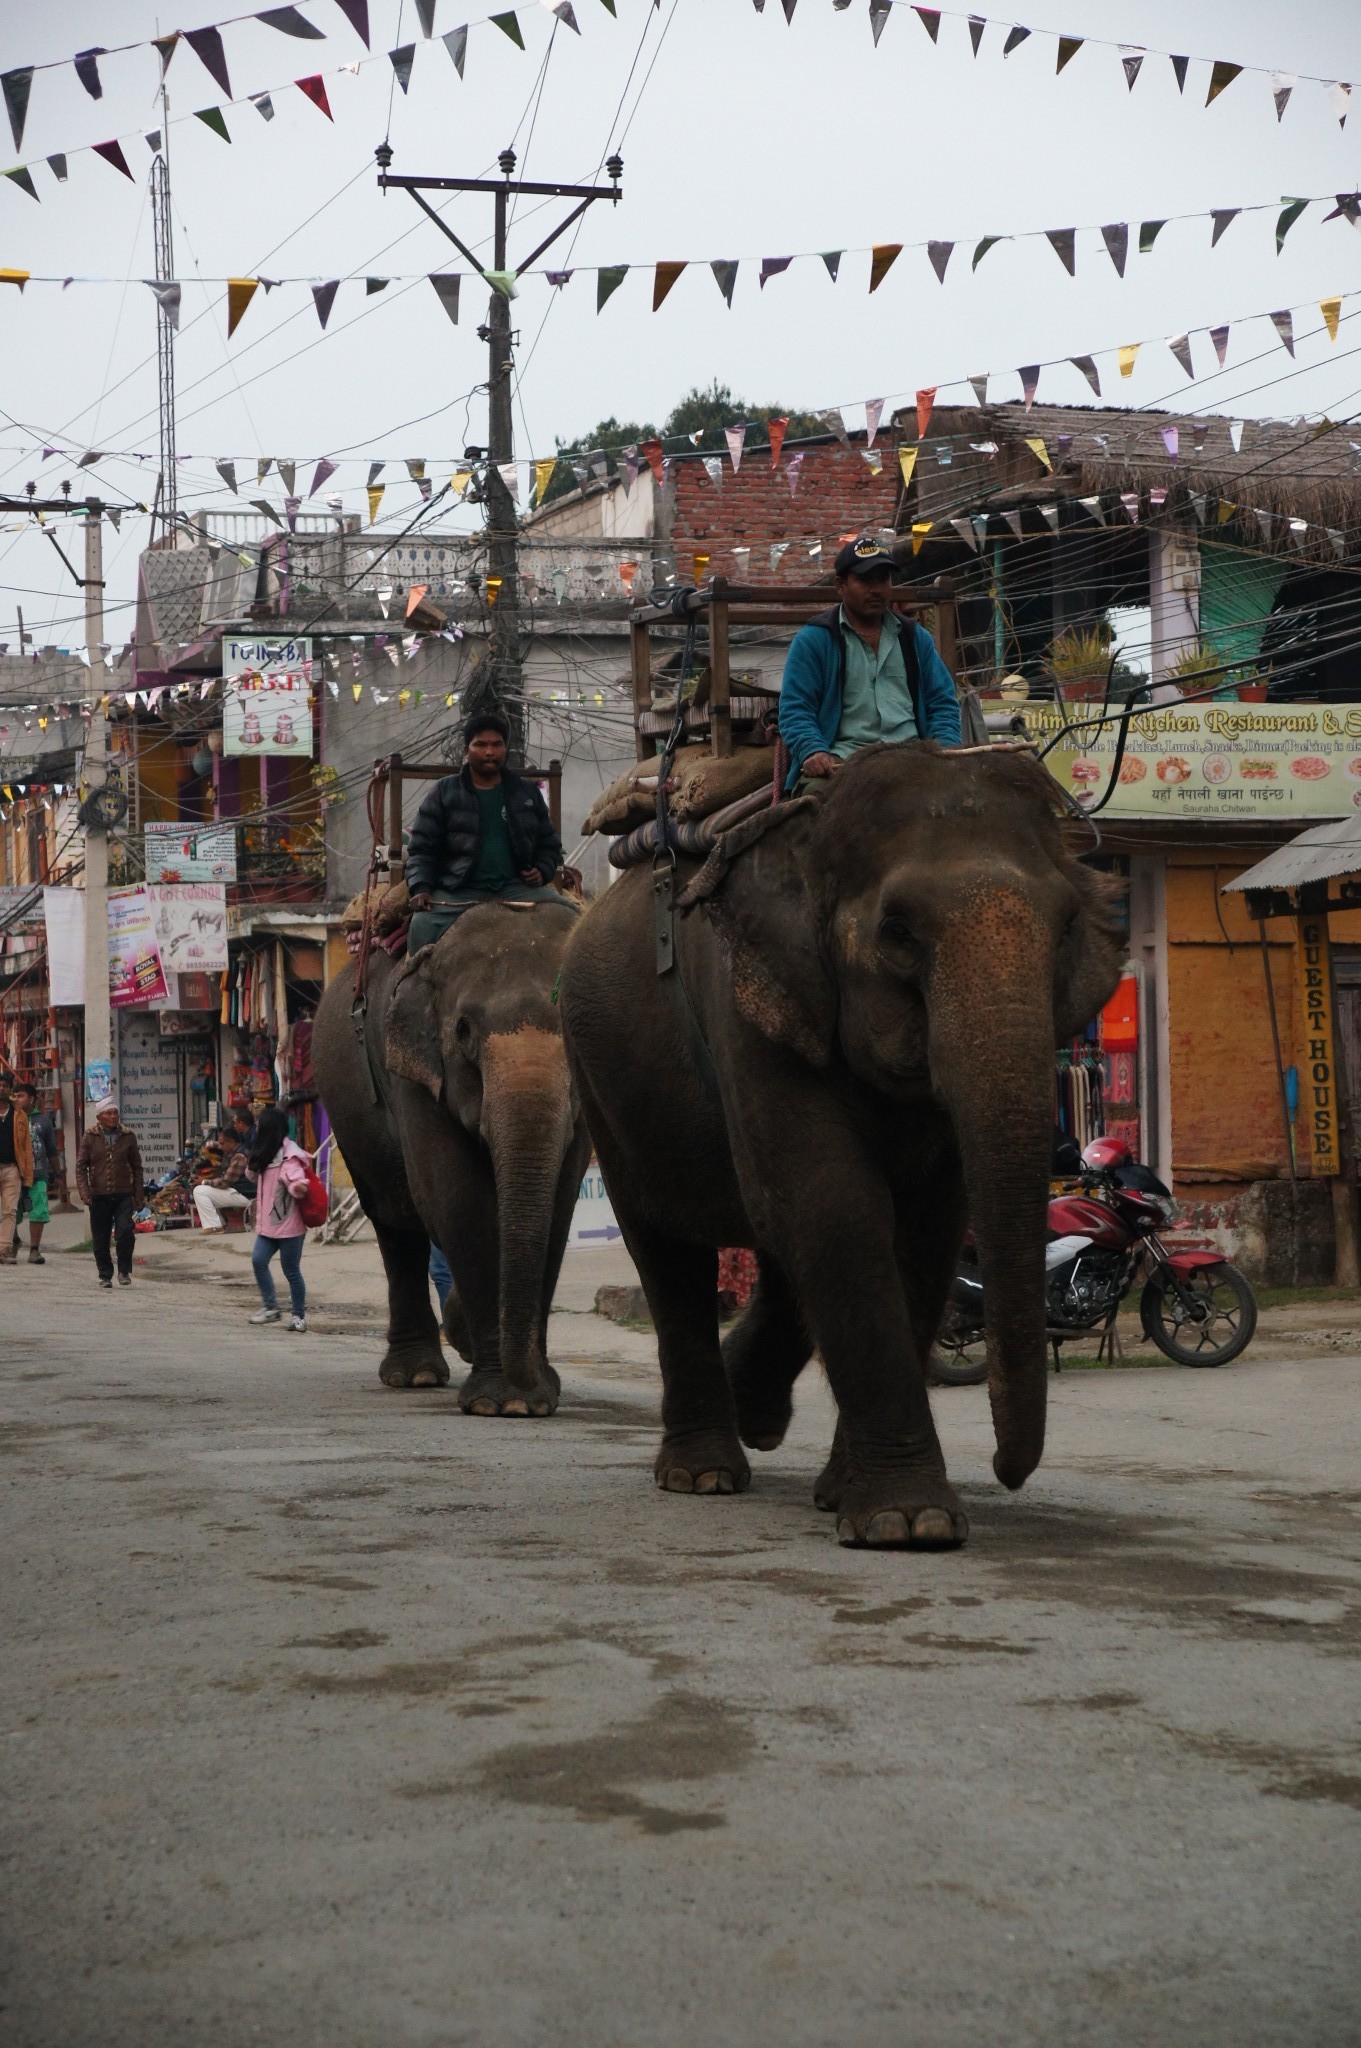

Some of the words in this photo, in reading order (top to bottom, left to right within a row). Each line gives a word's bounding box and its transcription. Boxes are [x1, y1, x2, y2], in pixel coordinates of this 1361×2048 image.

[1120, 711, 1199, 741] Kitchen
[1204, 709, 1318, 740] Restaurant
[1322, 710, 1343, 735] &
[1177, 786, 1211, 800] नेपाली
[1216, 788, 1243, 800] खाना
[135, 958, 156, 973] ROYAL
[139, 973, 157, 987] STAG
[1303, 925, 1327, 1030] GUEST
[1309, 1039, 1331, 1154] HOUSE
[123, 1104, 149, 1114] Shower
[151, 1103, 162, 1114] Gel
